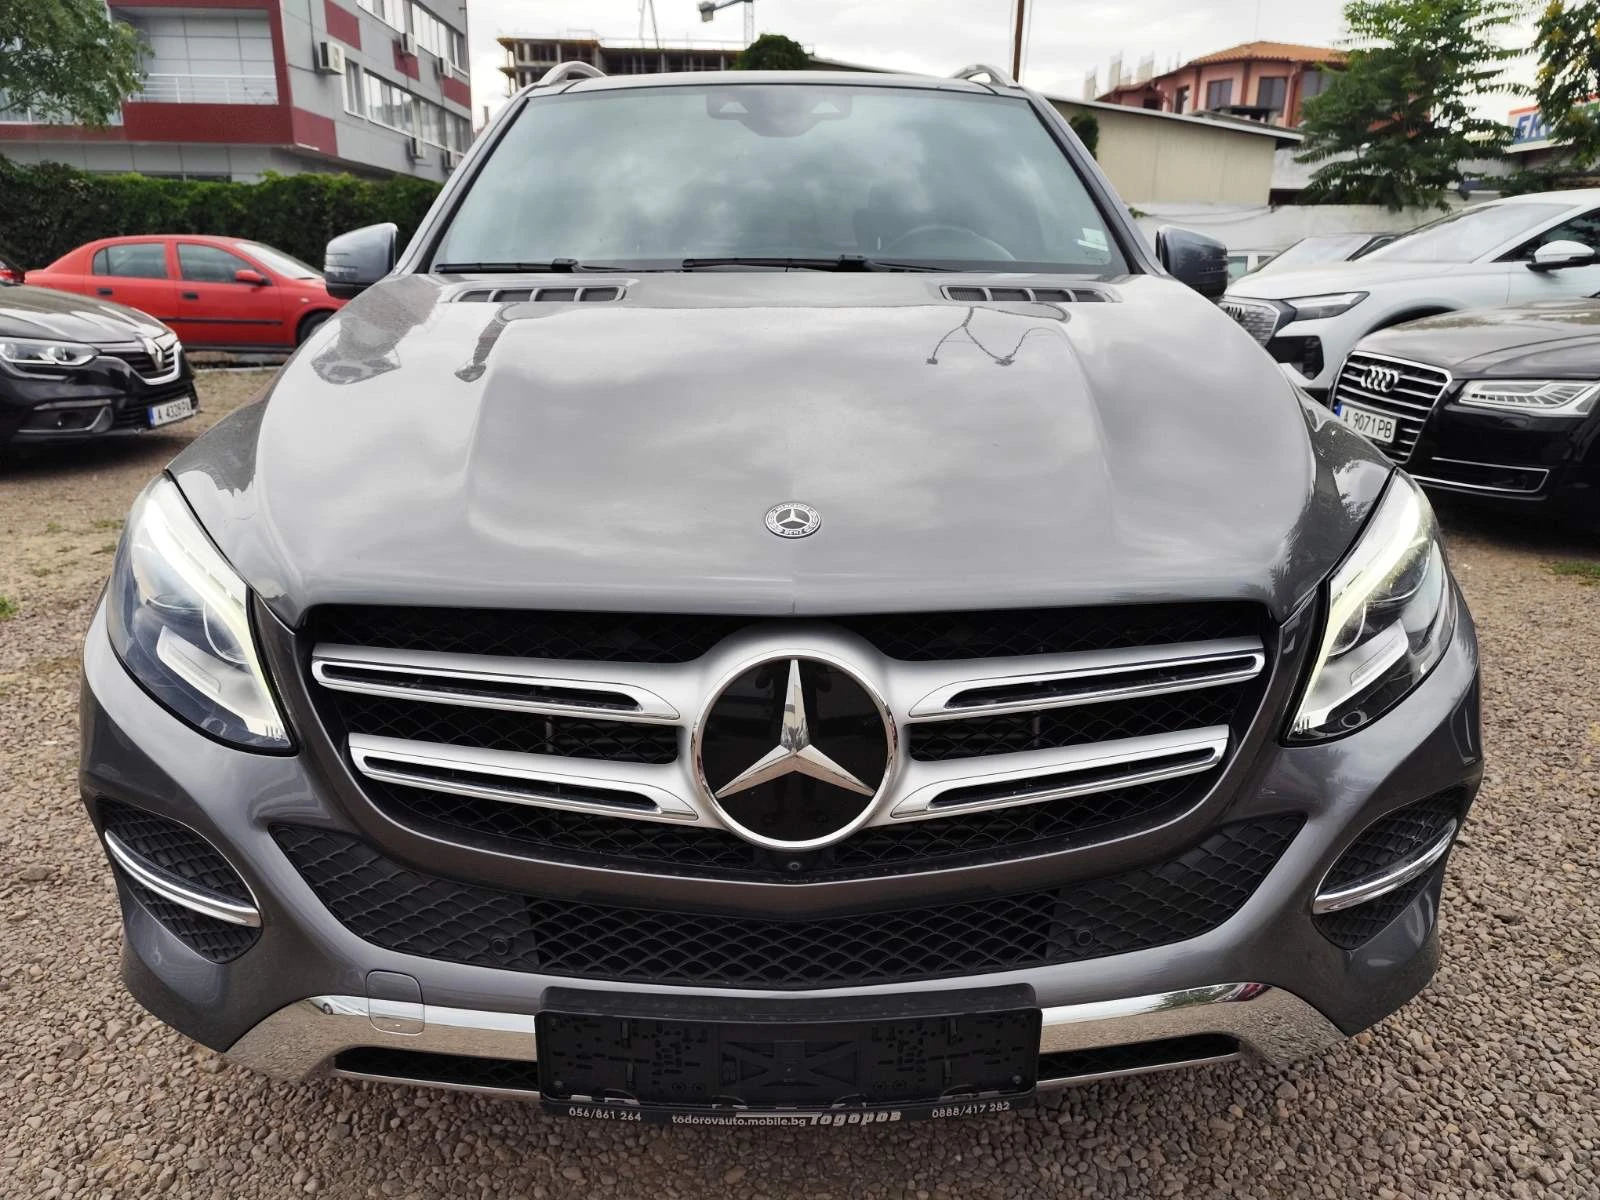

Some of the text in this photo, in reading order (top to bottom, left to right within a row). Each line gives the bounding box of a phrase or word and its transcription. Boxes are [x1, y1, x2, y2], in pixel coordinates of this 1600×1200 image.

[1353, 411, 1393, 439] 9071PB
[569, 1107, 642, 1122] 056/861 264
[932, 1102, 1011, 1119] 0888/417 282
[672, 1115, 806, 1126] todorovauto.mobile.bg
